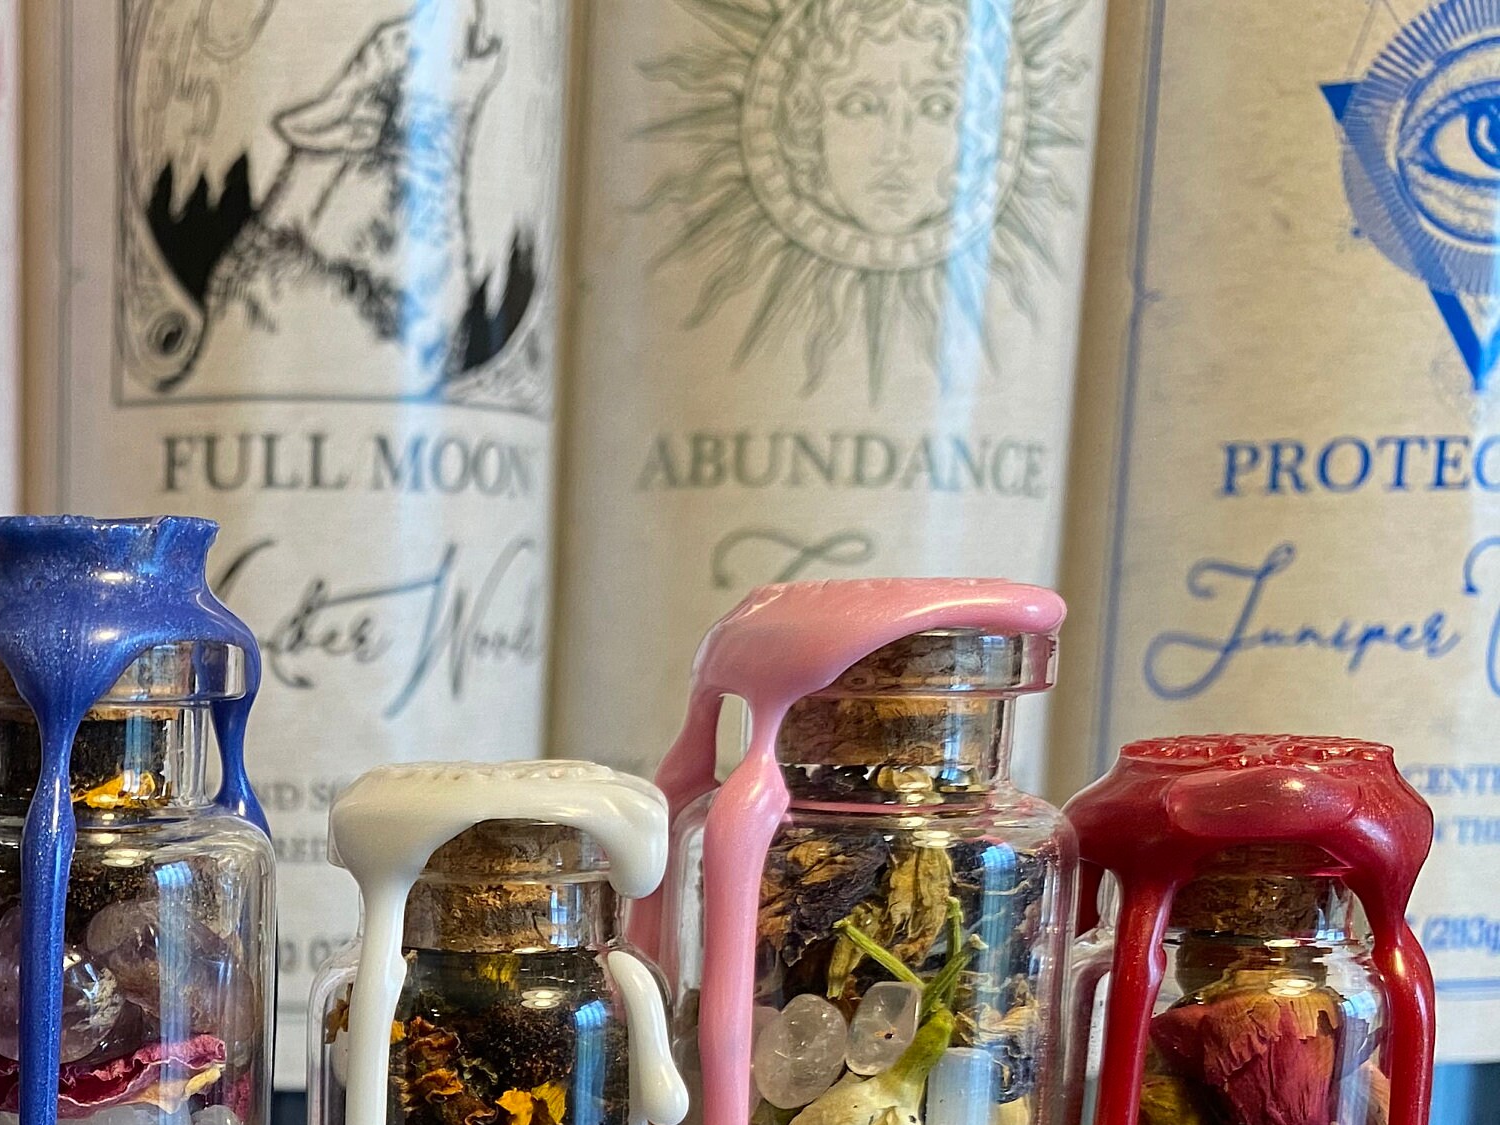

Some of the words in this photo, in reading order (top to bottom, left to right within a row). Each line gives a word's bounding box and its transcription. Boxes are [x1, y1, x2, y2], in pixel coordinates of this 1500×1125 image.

[160, 431, 348, 493] FULL
[372, 433, 536, 498] MOON
[637, 430, 1049, 498] ABUNDANCE
[1143, 542, 1462, 700] Juniper
